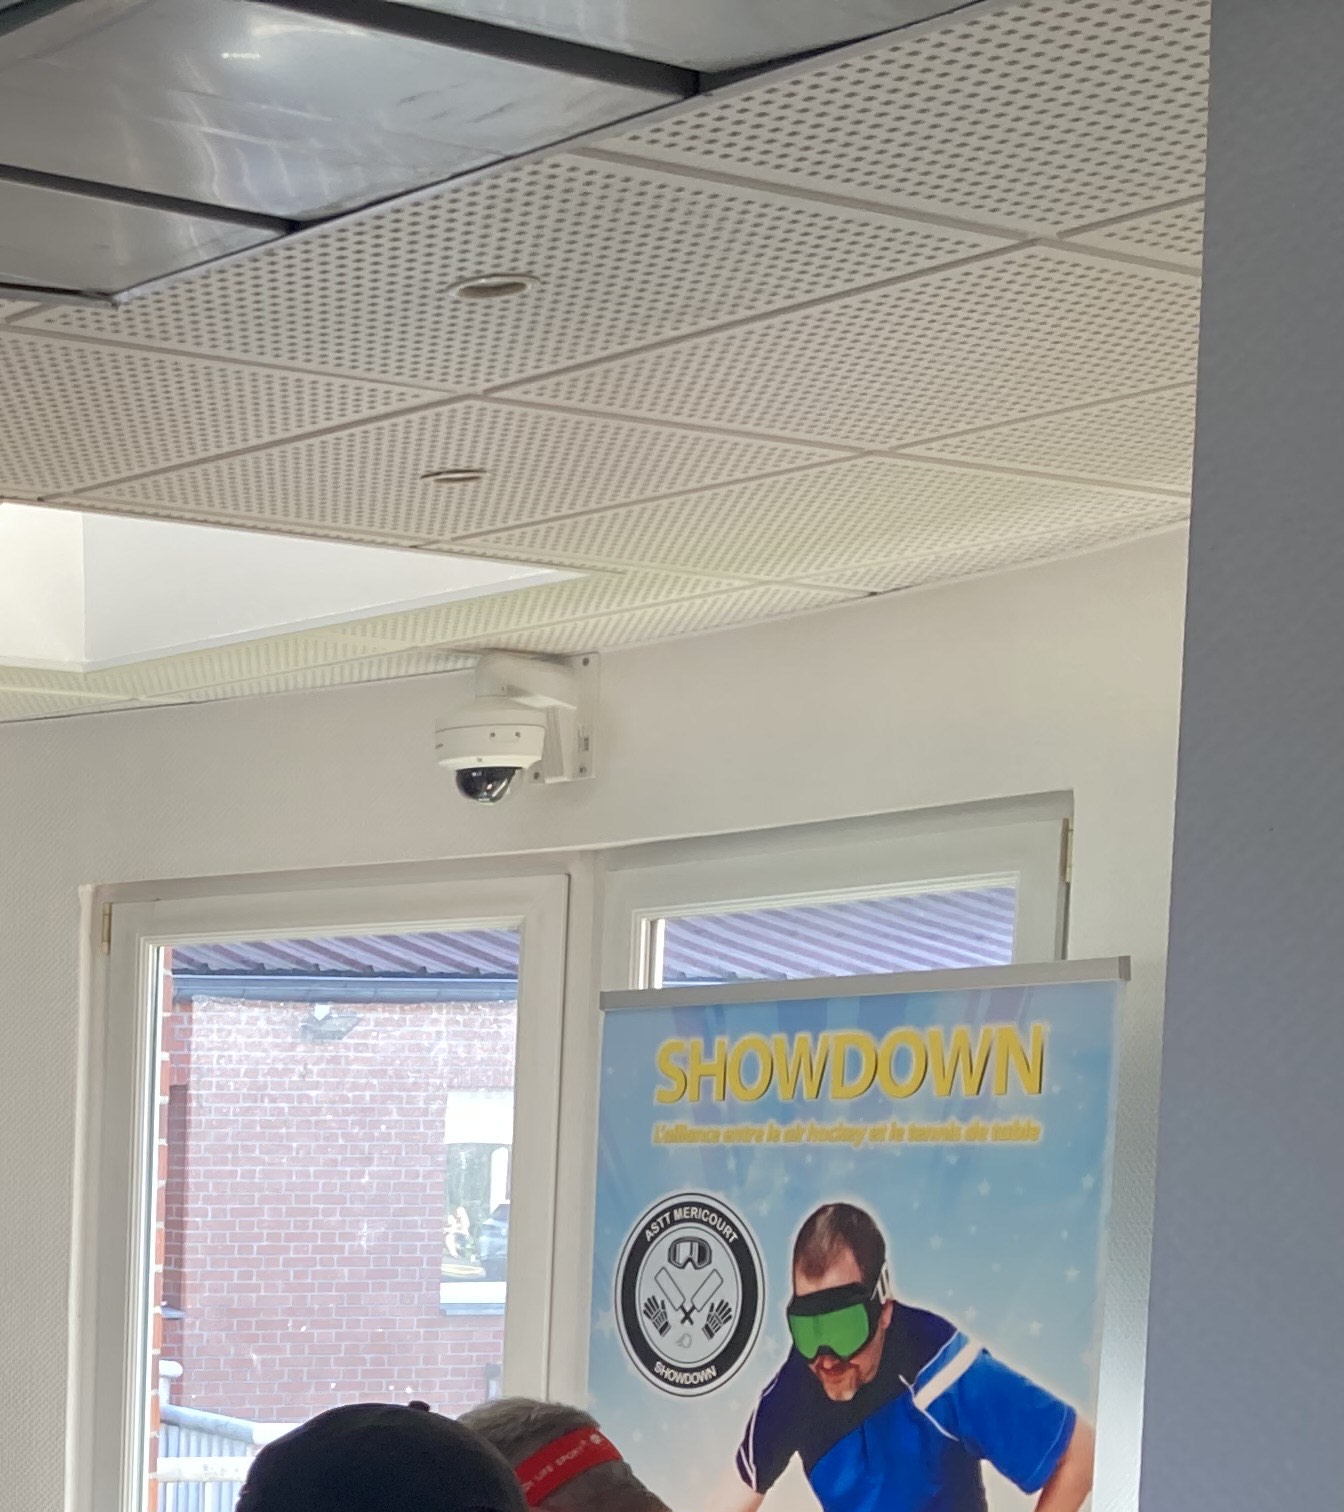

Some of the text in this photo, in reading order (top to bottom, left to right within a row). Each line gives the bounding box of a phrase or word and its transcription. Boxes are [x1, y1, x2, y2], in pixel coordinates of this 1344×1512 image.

[656, 1024, 1044, 1103] SHOWDOWN
[645, 1206, 739, 1244] ASTT MERICOURT
[653, 1361, 718, 1385] SHOWDOWN
